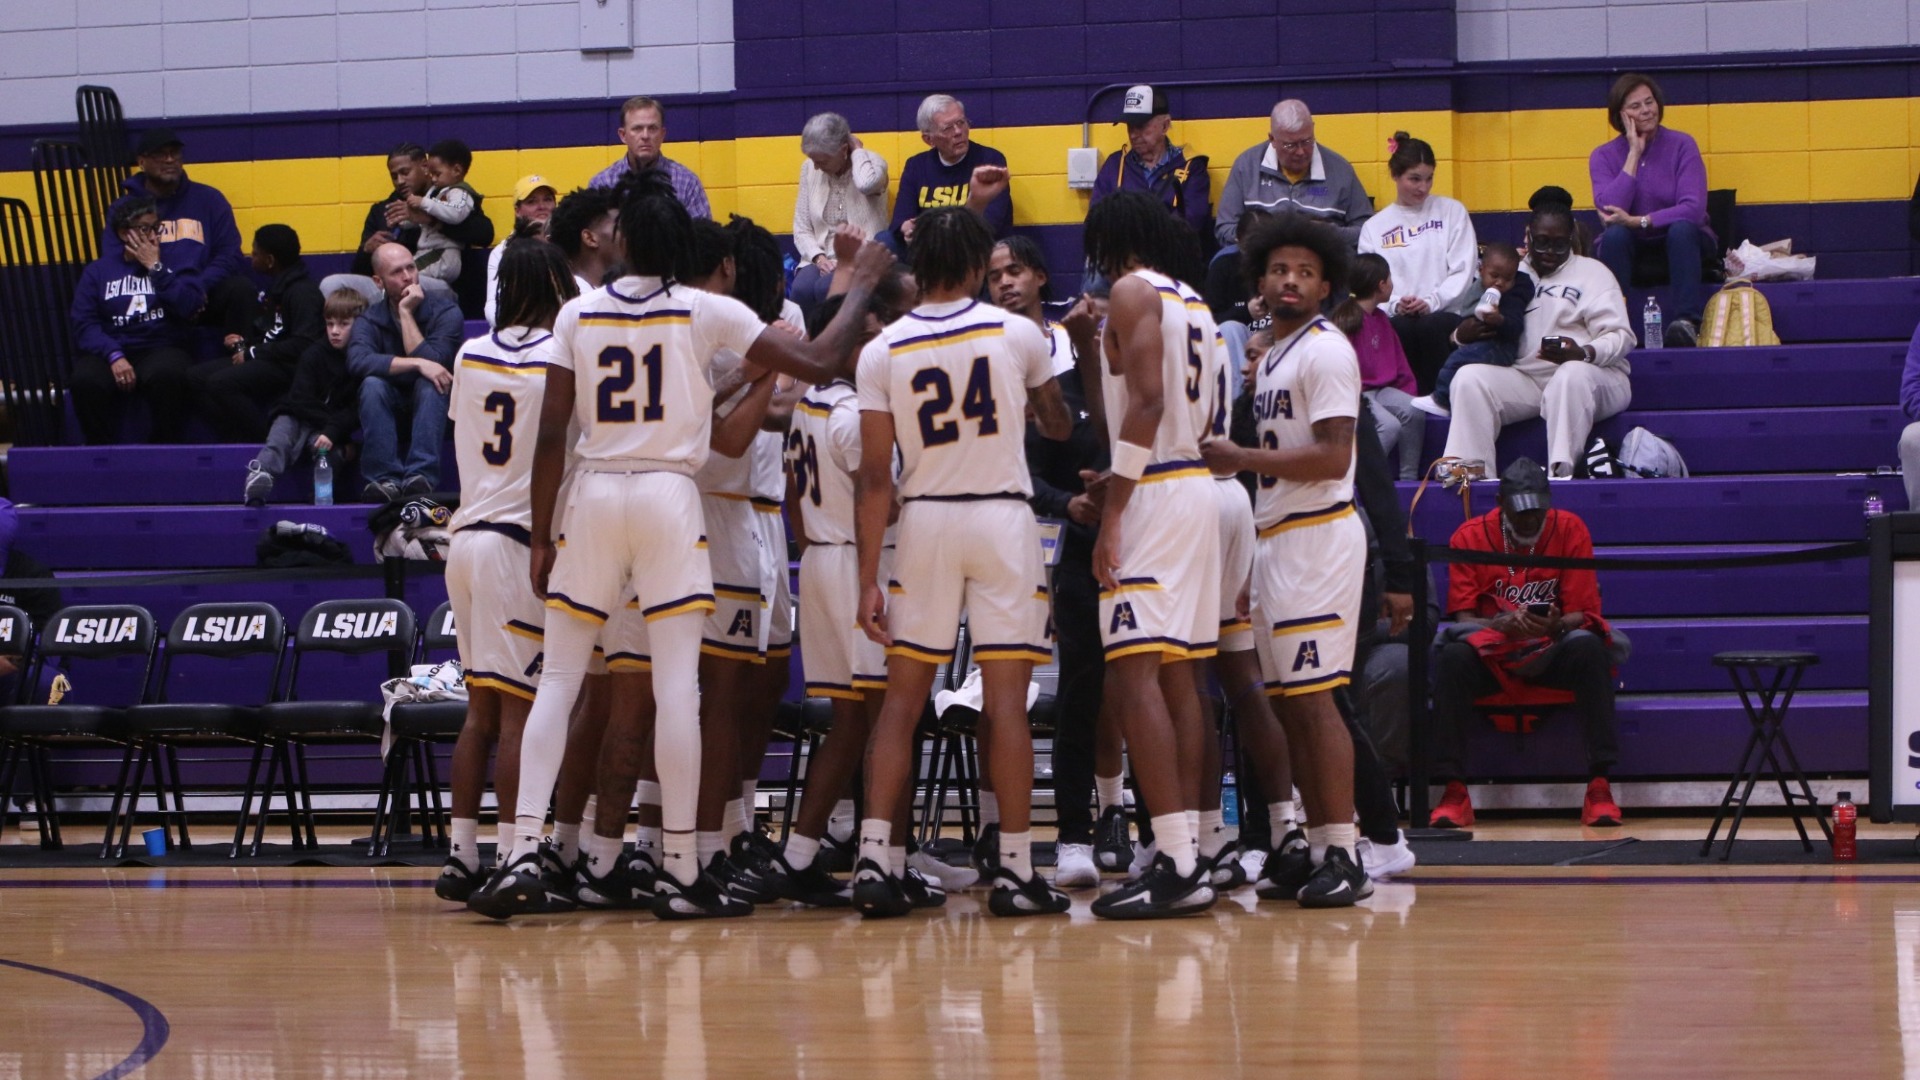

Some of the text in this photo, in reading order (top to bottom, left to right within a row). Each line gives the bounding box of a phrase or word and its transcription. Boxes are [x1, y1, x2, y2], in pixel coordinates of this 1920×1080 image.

[919, 184, 969, 208] LSU
[1408, 220, 1443, 238] LSUA
[597, 344, 664, 422] 21
[911, 356, 999, 449] 24
[482, 391, 516, 466] 3
[55, 617, 138, 643] LSUA
[183, 615, 266, 642] LSUA
[312, 611, 398, 638] LSUA
